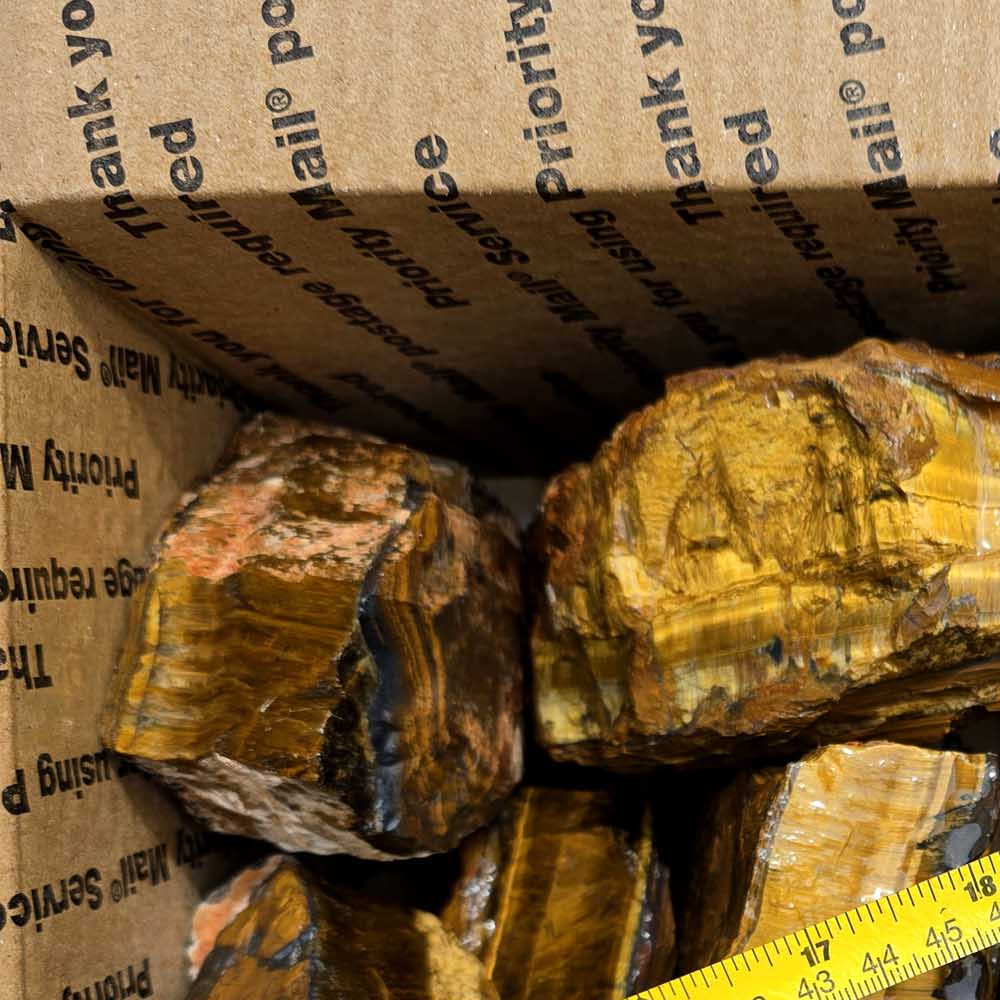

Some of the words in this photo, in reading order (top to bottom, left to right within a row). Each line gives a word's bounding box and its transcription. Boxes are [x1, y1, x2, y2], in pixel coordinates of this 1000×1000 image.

[64, 77, 167, 239] Thank
[265, 87, 354, 221] Mail®
[637, 67, 724, 226] Thank
[724, 109, 832, 261] required
[839, 79, 917, 212] Mail®
[150, 116, 309, 277] required
[414, 134, 530, 266] Service
[20, 221, 137, 291] using
[342, 226, 471, 310] Priority
[570, 208, 656, 272] using
[893, 214, 967, 295] Priority
[130, 298, 199, 326] for
[301, 281, 440, 357] postage
[637, 277, 690, 307] for
[100, 343, 162, 396] Mail®
[192, 330, 272, 361] you
[43, 438, 140, 500] Priority
[37, 748, 112, 799] using
[0, 867, 104, 933] Servic
[801, 940, 831, 967] 17
[963, 874, 998, 902] 18
[798, 970, 836, 1000] 43
[862, 943, 900, 974] 44
[925, 918, 964, 949] 45
